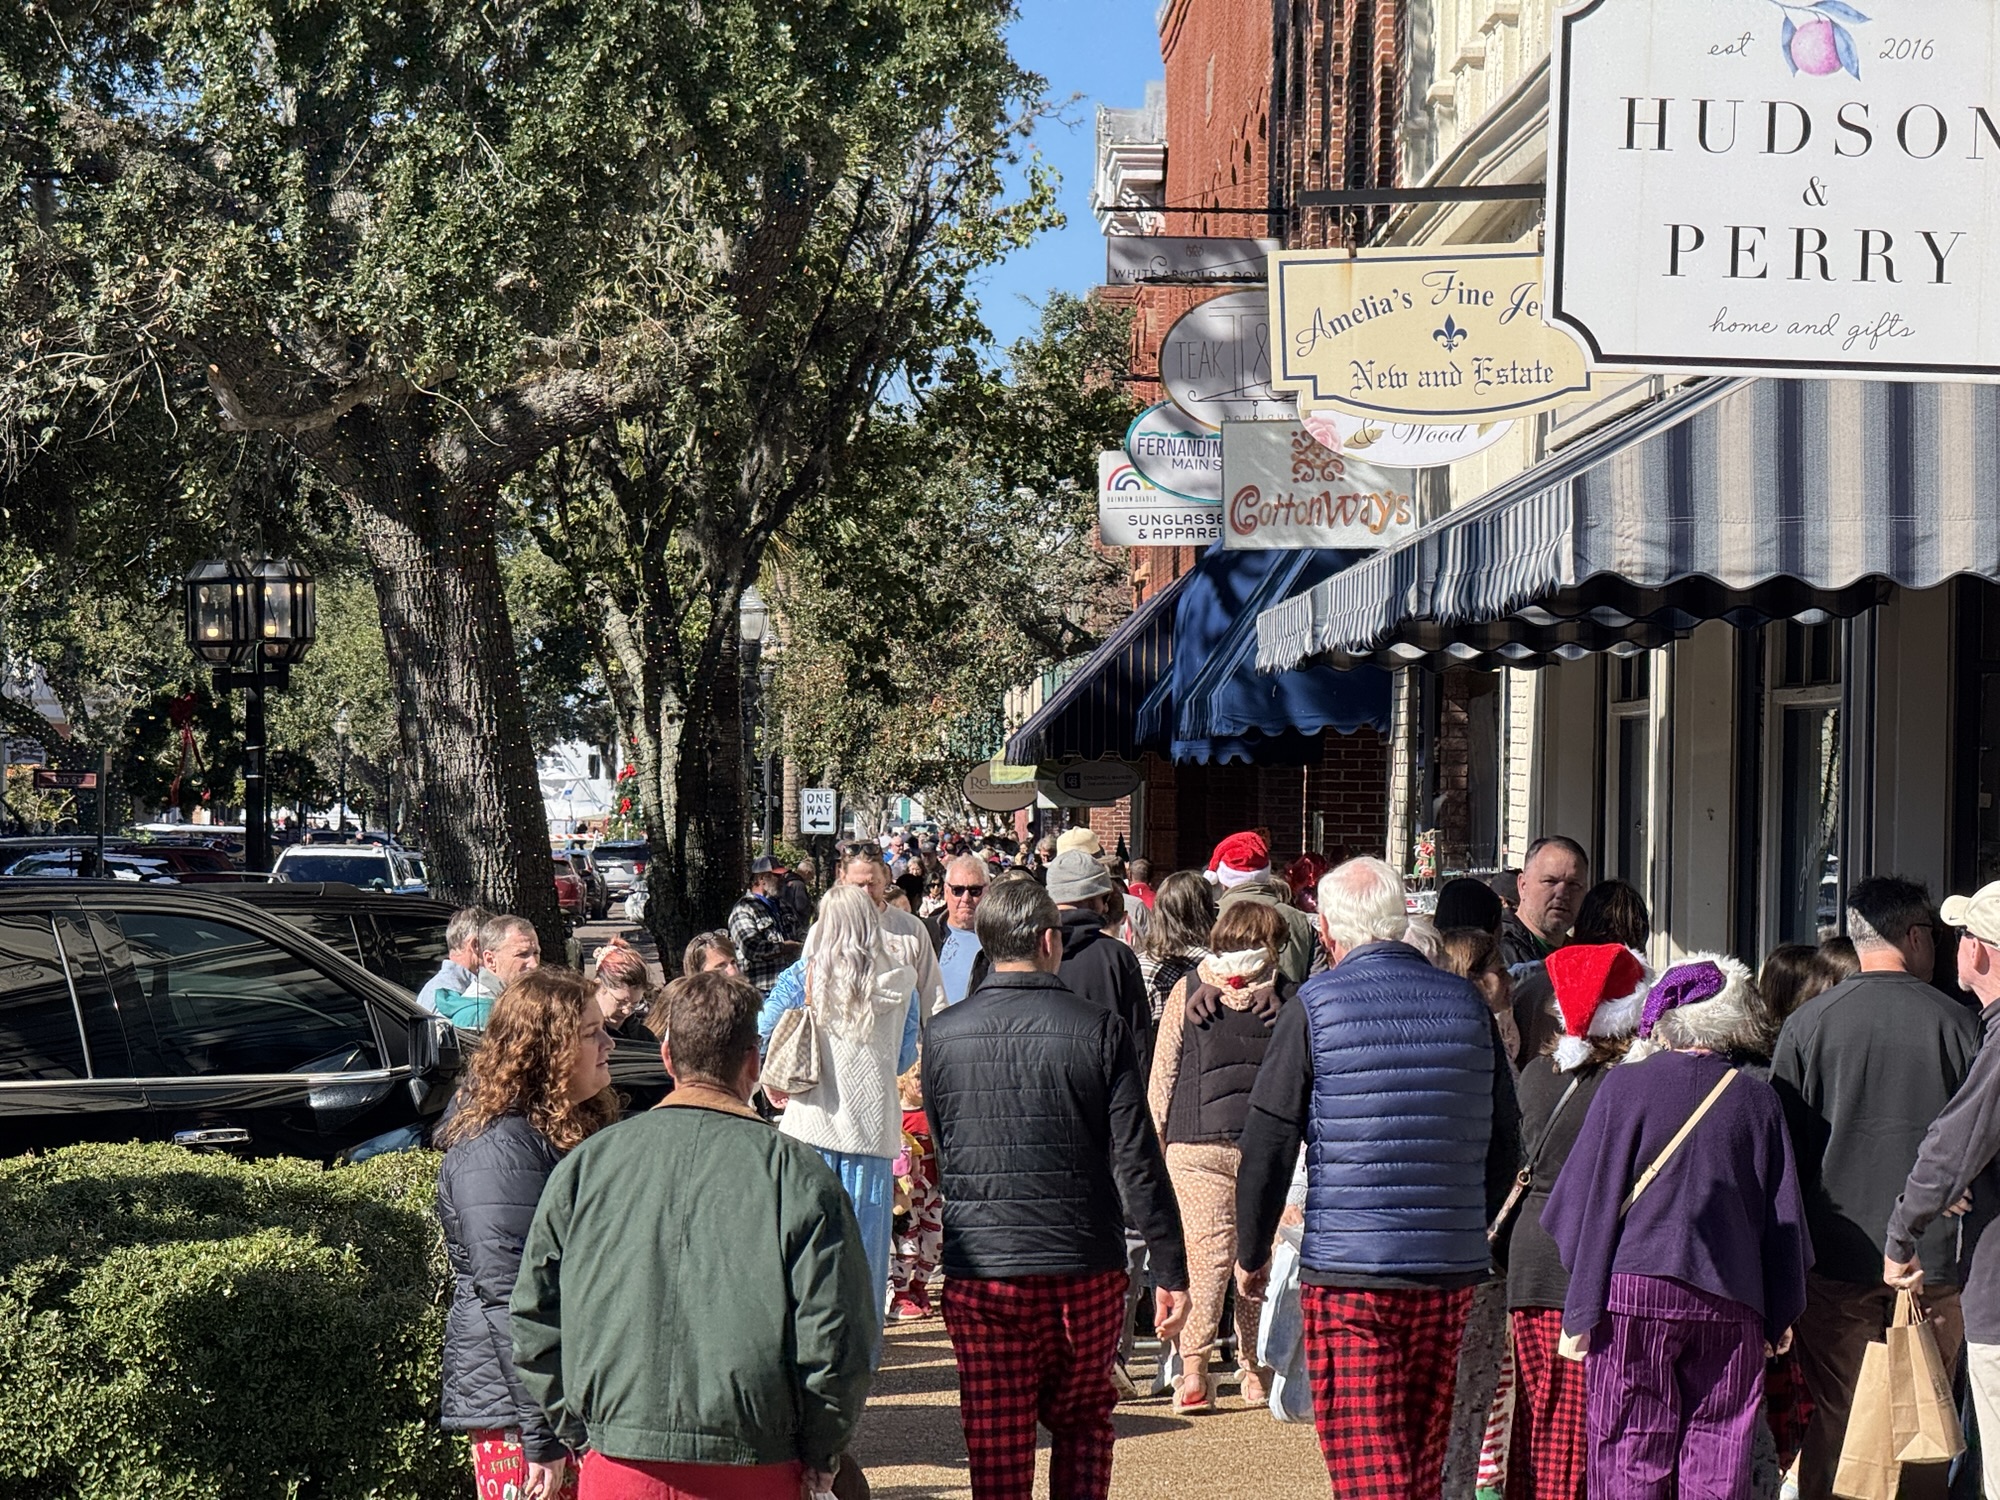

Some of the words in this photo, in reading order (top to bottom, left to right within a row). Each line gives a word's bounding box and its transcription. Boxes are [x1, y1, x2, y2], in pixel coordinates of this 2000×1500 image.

[1707, 31, 1755, 57] est
[1879, 37, 1934, 60] 2016
[1802, 175, 1829, 207] &
[1661, 223, 1967, 285] PERRY
[1295, 288, 1413, 358] Amelia's
[1421, 269, 1494, 307] Fine
[1499, 282, 1543, 325] Je
[1709, 306, 1778, 334] home
[1786, 312, 1841, 337] and
[1842, 311, 1916, 351] gifts
[1175, 340, 1225, 380] TEAK
[1349, 360, 1408, 399] New
[1418, 361, 1463, 388] and
[1471, 357, 1554, 396] Estate
[1392, 422, 1468, 445] Wood
[1137, 437, 1222, 458] FERNANDIN
[1171, 458, 1209, 470] MAIN
[1212, 459, 1223, 471] S
[1127, 513, 1223, 526] SUNGLASSE
[1138, 528, 1148, 540] &
[806, 805, 832, 816] WAY
[807, 793, 832, 804] ONE
